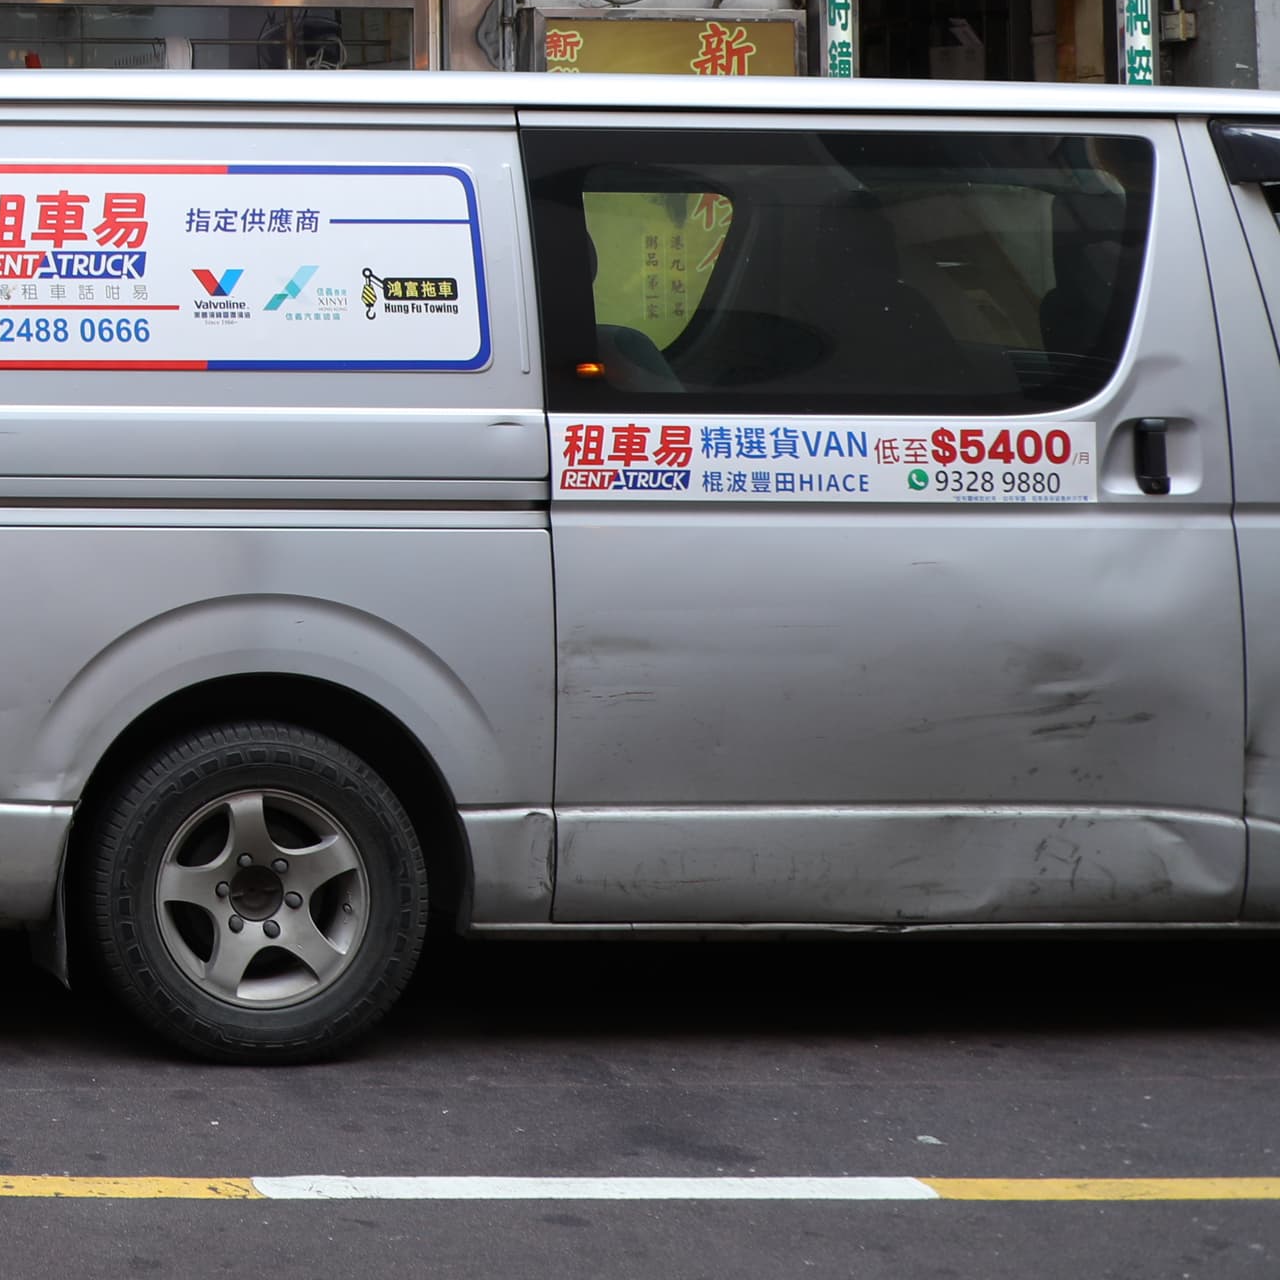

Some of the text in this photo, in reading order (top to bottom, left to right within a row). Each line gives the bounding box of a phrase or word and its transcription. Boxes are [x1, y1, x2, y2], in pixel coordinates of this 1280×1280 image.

[185, 208, 321, 233] 指定供應商
[386, 280, 454, 298] 鴻富拖車
[193, 300, 247, 310] Valvoline
[318, 297, 348, 306] XINYI
[384, 303, 458, 315] Hung Fu Towing
[0, 318, 150, 342] 2488 0666
[563, 423, 692, 467] 租車易
[935, 470, 1061, 494] 9328 9880
